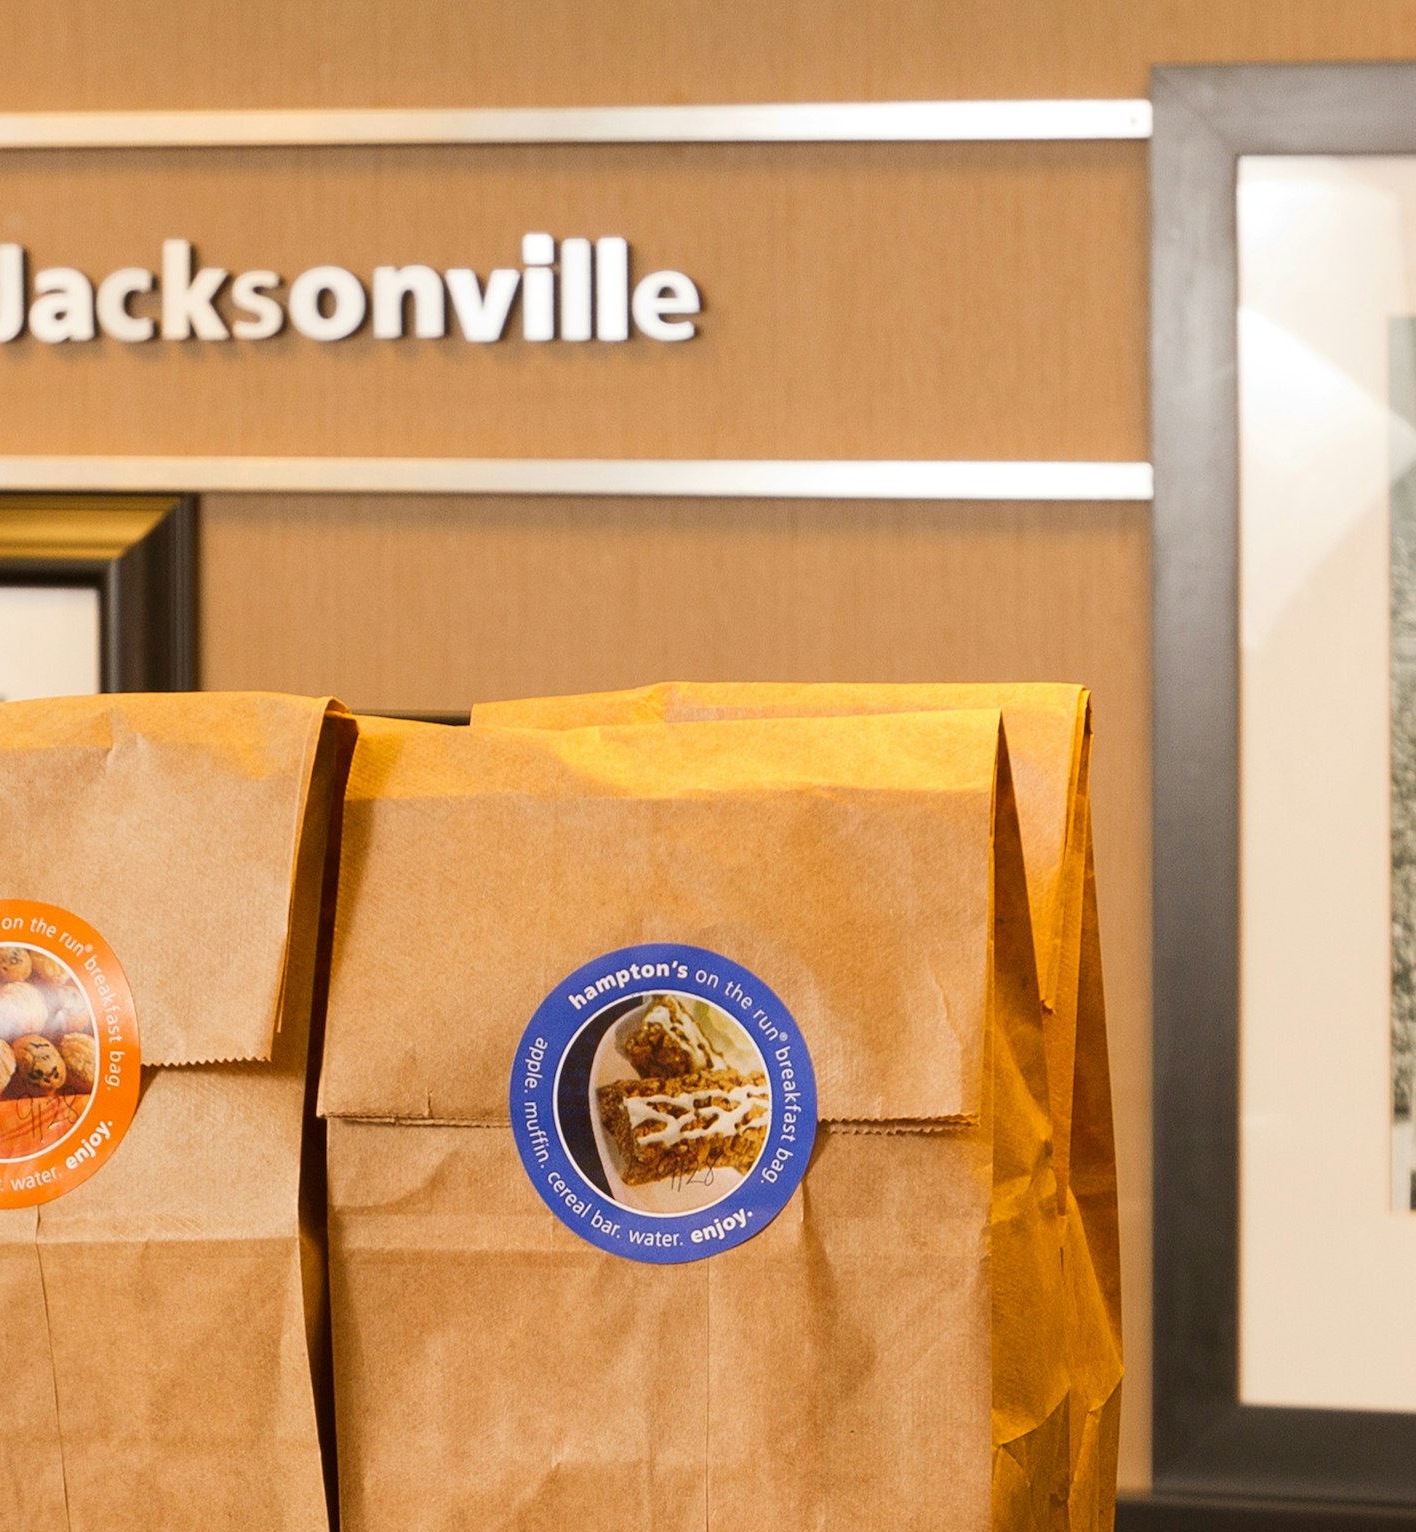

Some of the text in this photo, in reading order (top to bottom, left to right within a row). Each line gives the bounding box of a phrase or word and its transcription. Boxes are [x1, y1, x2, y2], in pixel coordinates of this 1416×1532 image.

[1, 917, 24, 931] on
[29, 917, 57, 938] the
[84, 954, 123, 1042] breakfast
[695, 969, 720, 988] on
[724, 980, 753, 1009] the
[774, 1046, 802, 1142] breakfast
[65, 1119, 113, 1171] enjoy.
[524, 1037, 753, 1248] apple. muffin. cereal bar. water. enjoy.
[760, 1147, 794, 1185] bag.
